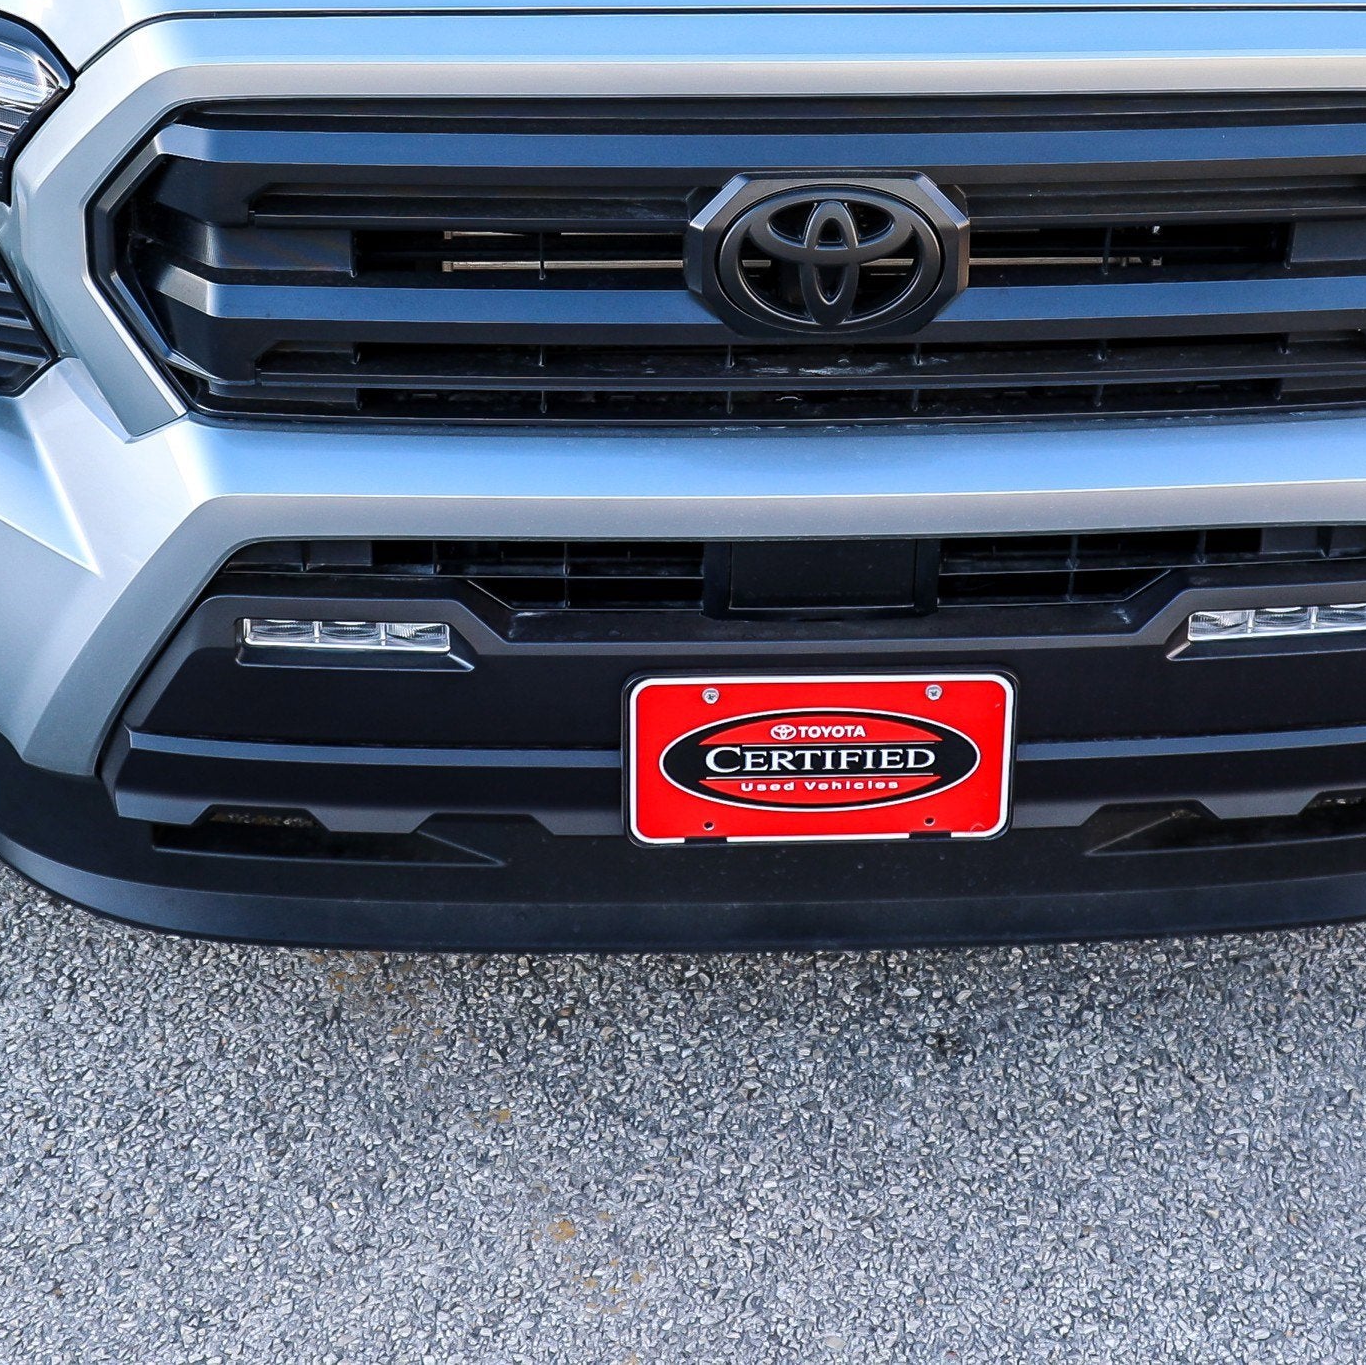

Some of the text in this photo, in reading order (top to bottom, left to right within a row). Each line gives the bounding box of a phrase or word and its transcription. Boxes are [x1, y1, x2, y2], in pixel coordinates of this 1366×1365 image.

[798, 725, 866, 738] TOYOTA
[705, 746, 935, 773] CERTIFIED
[740, 779, 899, 792] Used Vehicles
